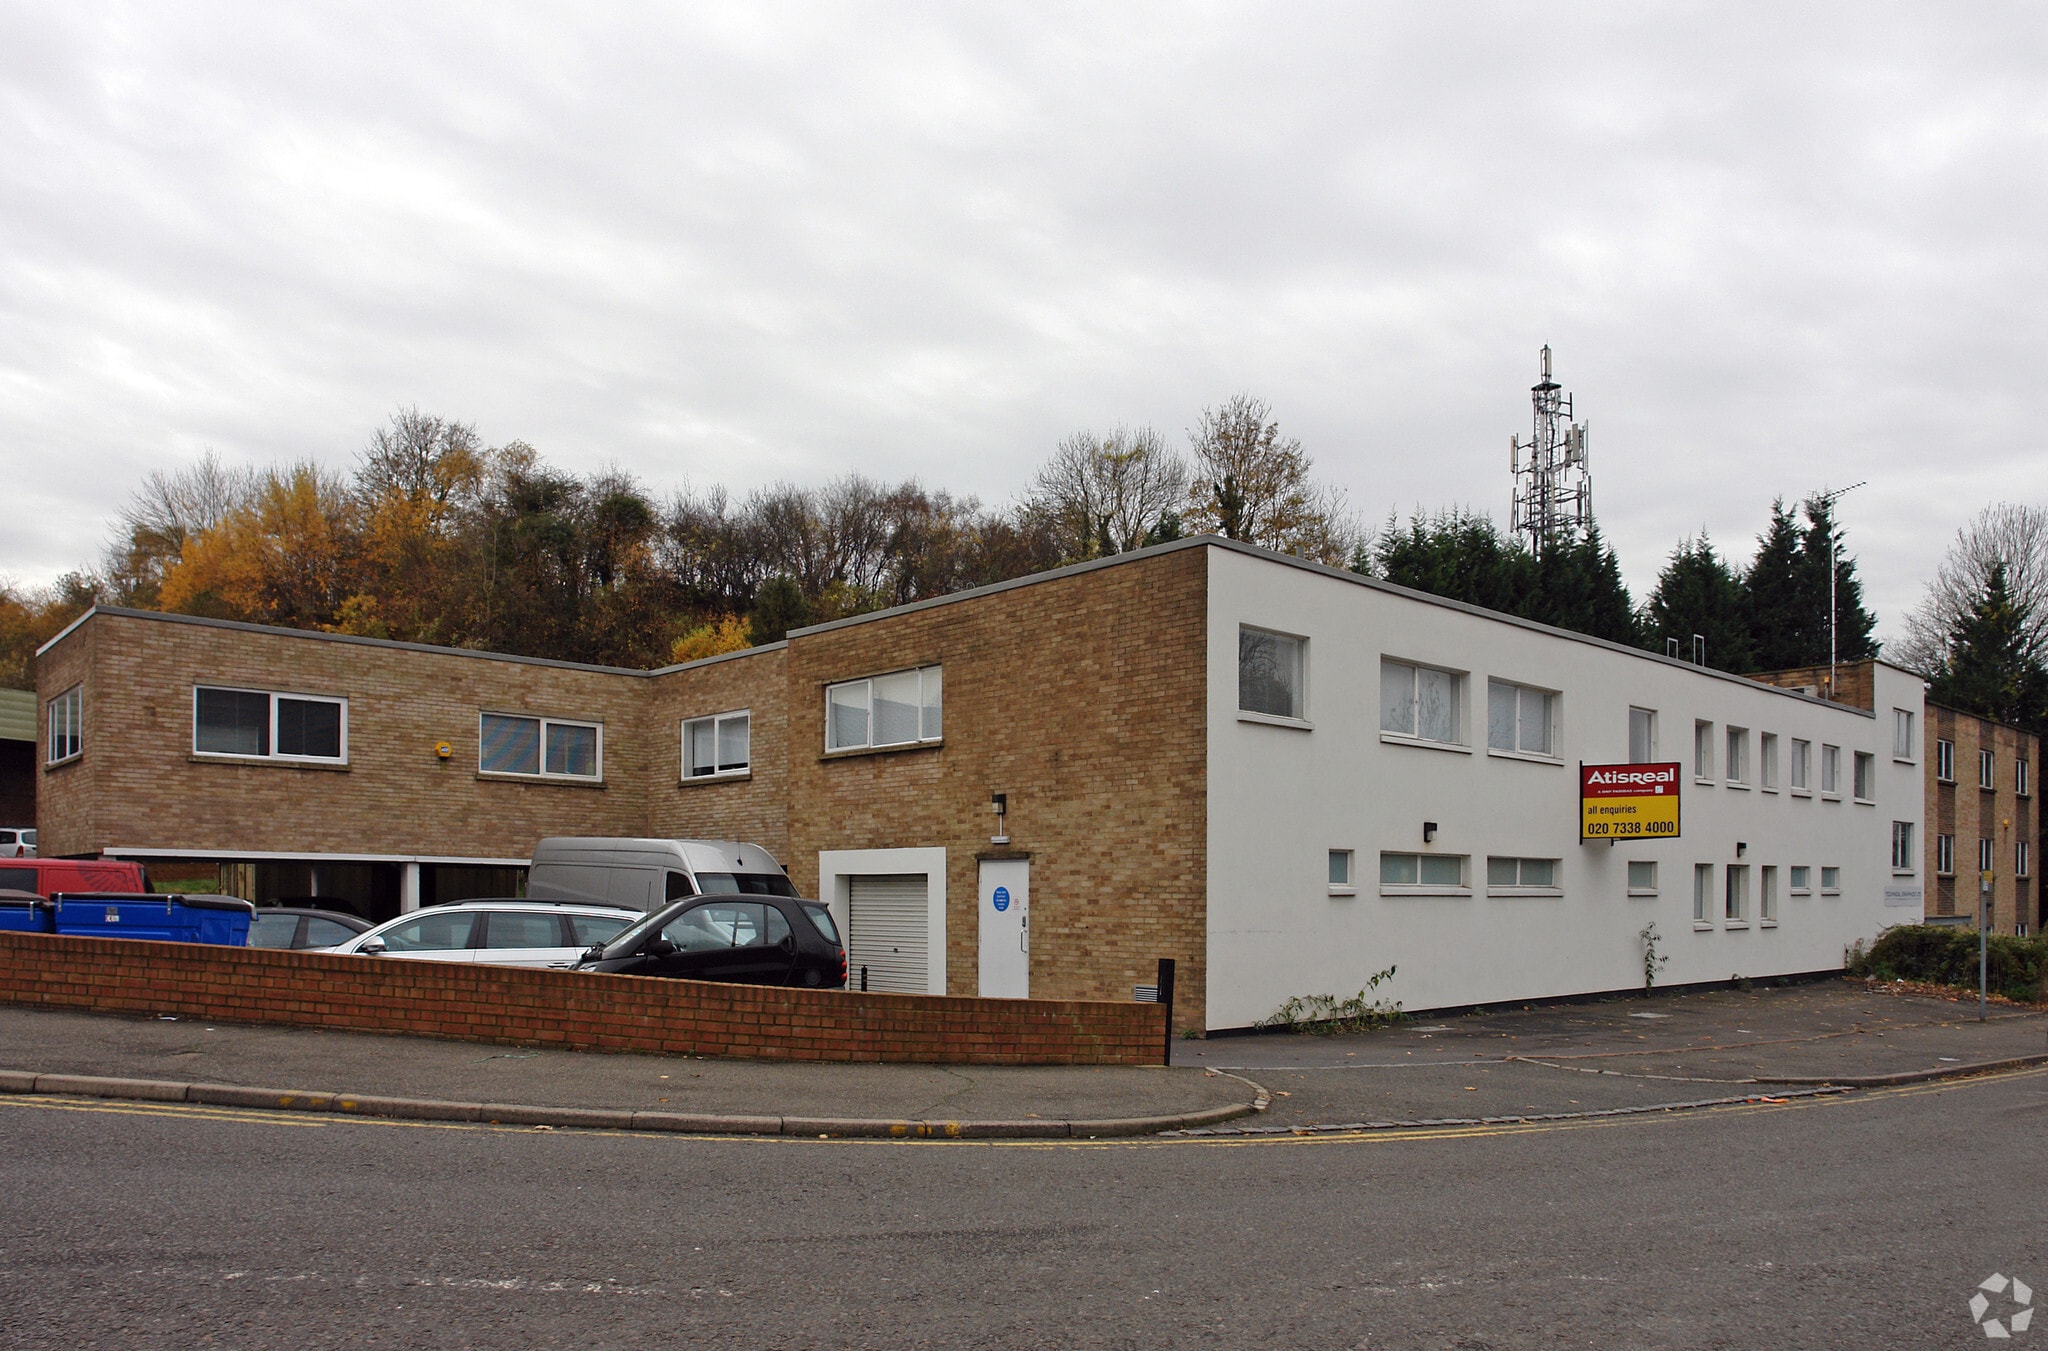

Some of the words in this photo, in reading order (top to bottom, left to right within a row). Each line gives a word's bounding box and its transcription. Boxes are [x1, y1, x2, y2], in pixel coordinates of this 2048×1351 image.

[1587, 805, 1598, 815] all
[1599, 804, 1637, 816] enquiries
[1587, 822, 1609, 835] 020
[1612, 821, 1641, 834] 7338
[1645, 820, 1675, 834] 4000
